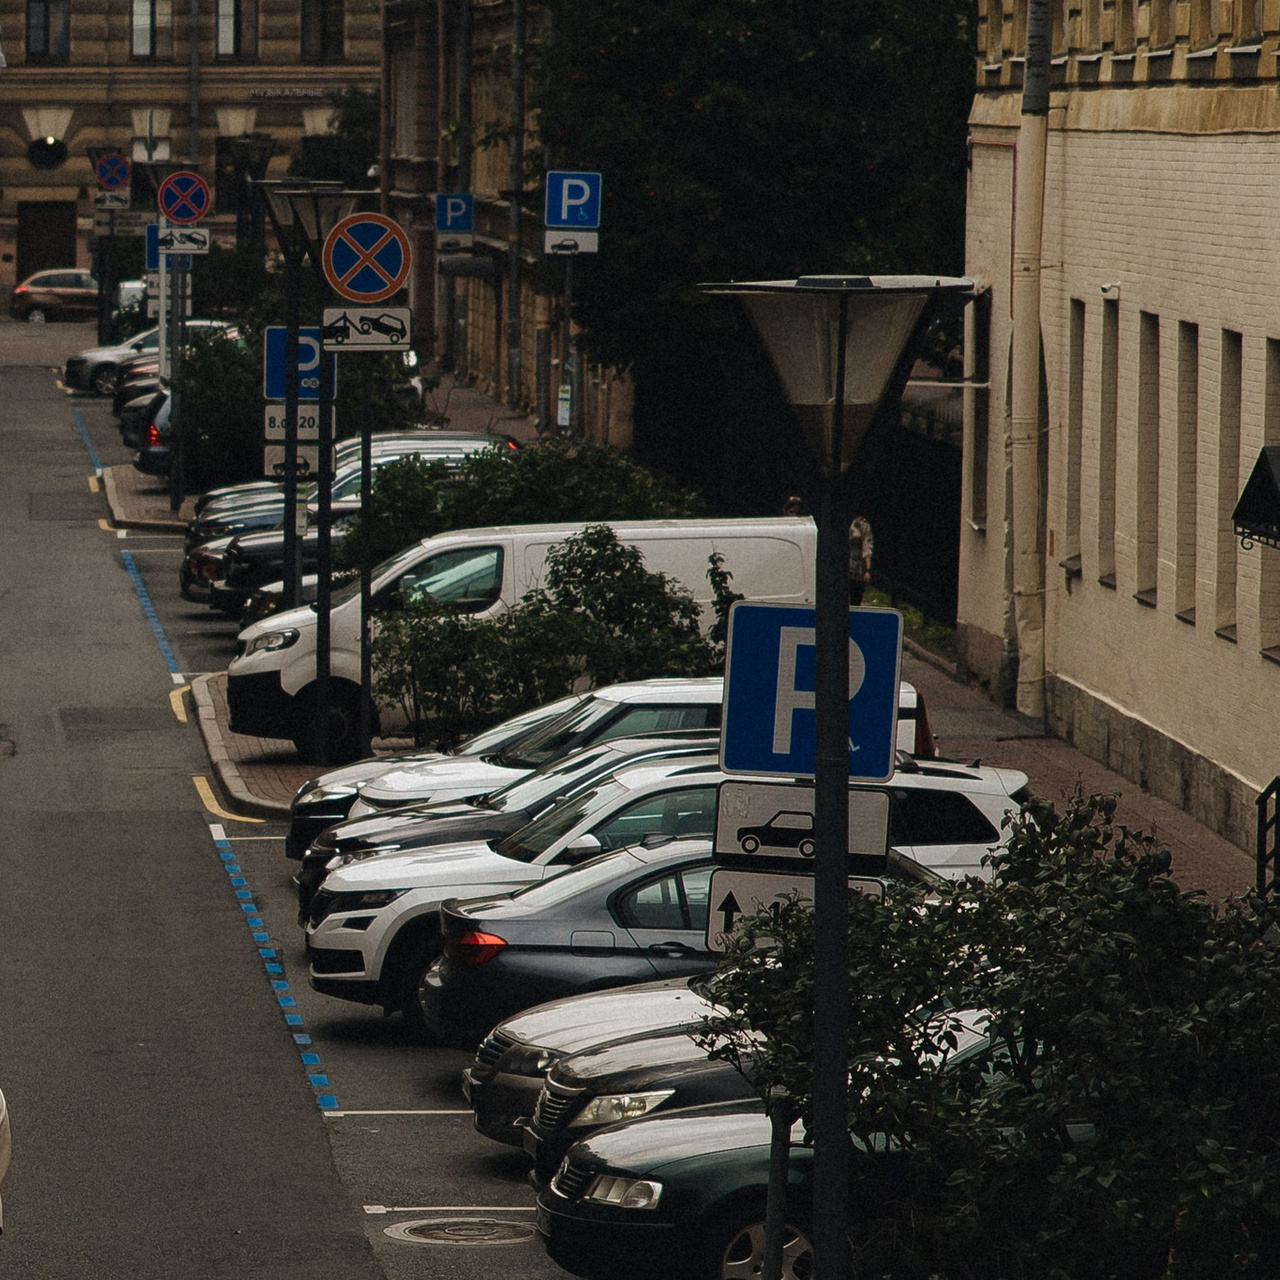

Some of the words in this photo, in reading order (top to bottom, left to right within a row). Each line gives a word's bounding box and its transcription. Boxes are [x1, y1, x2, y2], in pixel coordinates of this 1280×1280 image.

[446, 198, 466, 227] P
[561, 178, 591, 221] P
[772, 626, 866, 754] P
